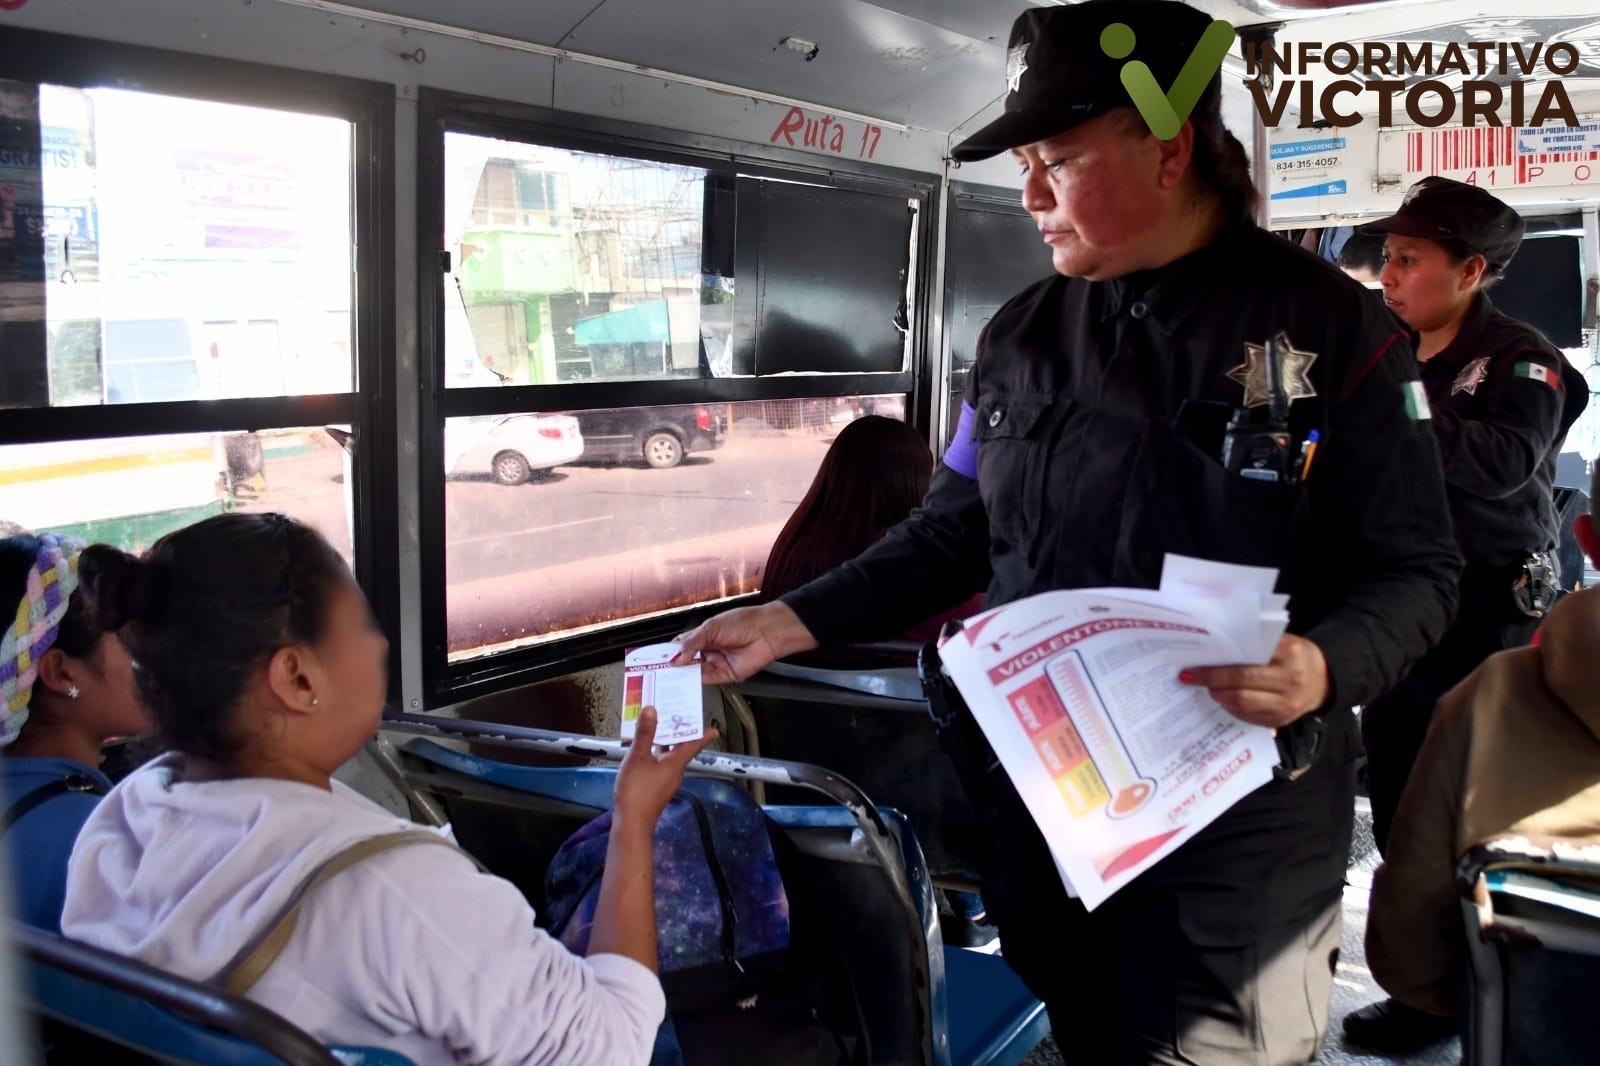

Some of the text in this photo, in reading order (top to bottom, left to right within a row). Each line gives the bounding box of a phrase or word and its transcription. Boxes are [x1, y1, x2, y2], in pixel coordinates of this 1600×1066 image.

[770, 106, 882, 159] Ruta 17
[1546, 126, 1565, 134] PUEDO
[1553, 134, 1585, 142] FORTALECE
[1271, 146, 1294, 155] QUEJAS
[1301, 142, 1344, 152] SUGERENCIAS
